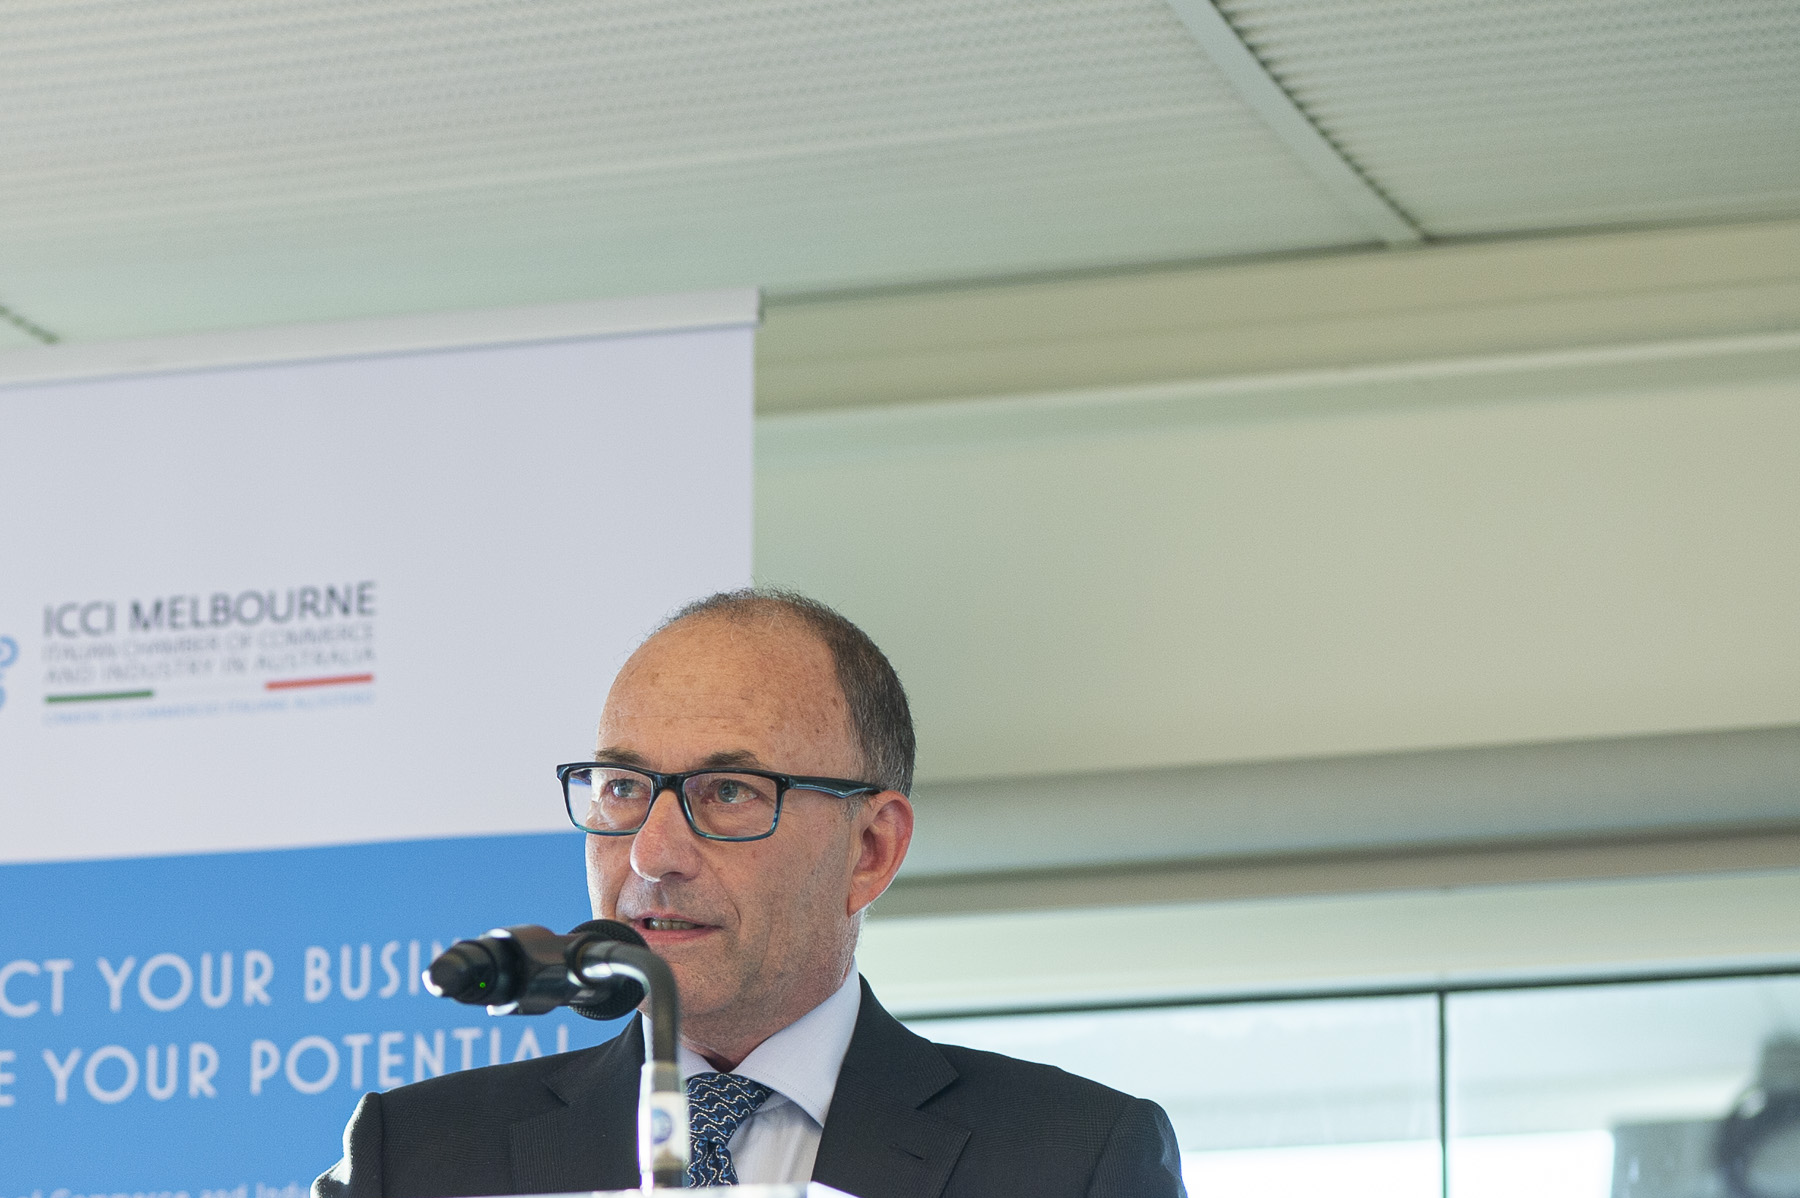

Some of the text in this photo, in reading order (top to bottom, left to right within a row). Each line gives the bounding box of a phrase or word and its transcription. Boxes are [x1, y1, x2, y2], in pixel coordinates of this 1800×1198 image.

[42, 580, 376, 638] ICCI MELBOURNE
[96, 949, 274, 1012] YOUR
[42, 1041, 219, 1105] YOUR
